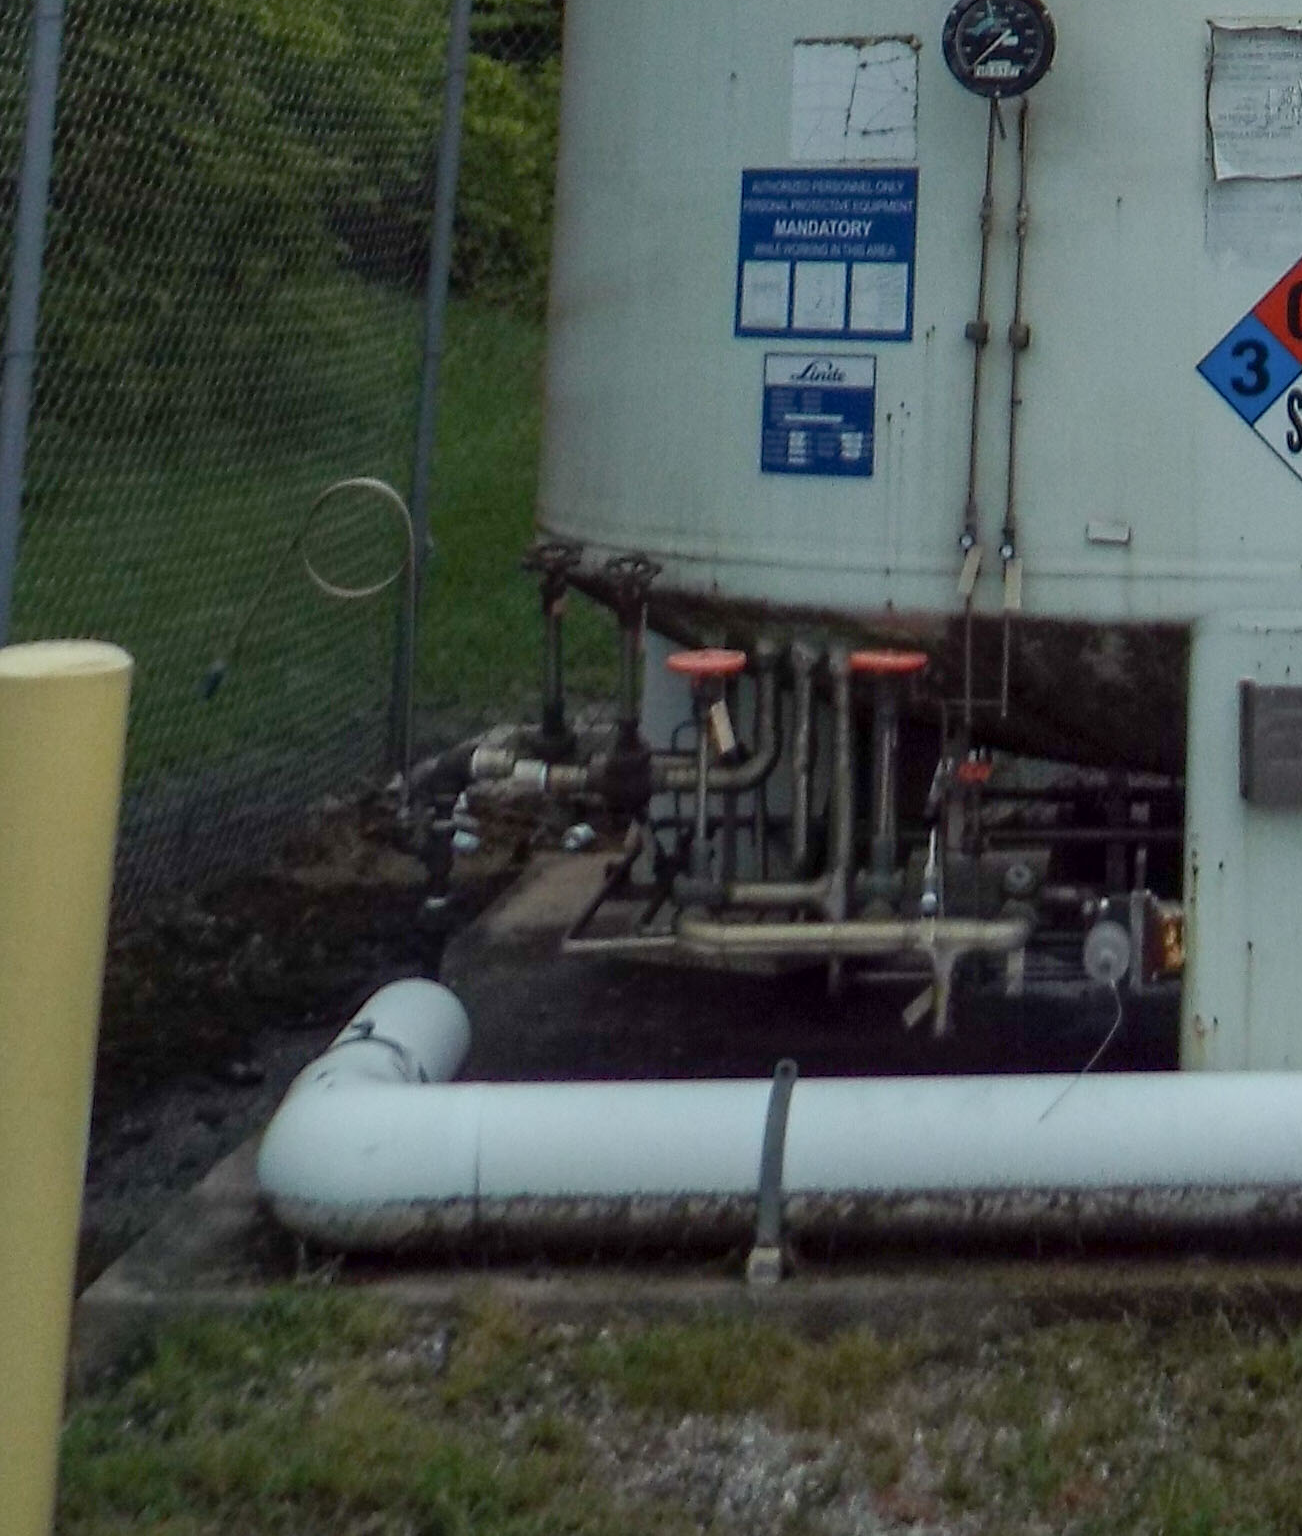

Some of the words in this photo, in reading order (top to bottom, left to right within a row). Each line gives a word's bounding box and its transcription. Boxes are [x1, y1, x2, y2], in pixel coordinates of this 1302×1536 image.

[773, 218, 873, 237] MANDATORY
[791, 360, 847, 382] Linde
[1230, 339, 1271, 398] 3
